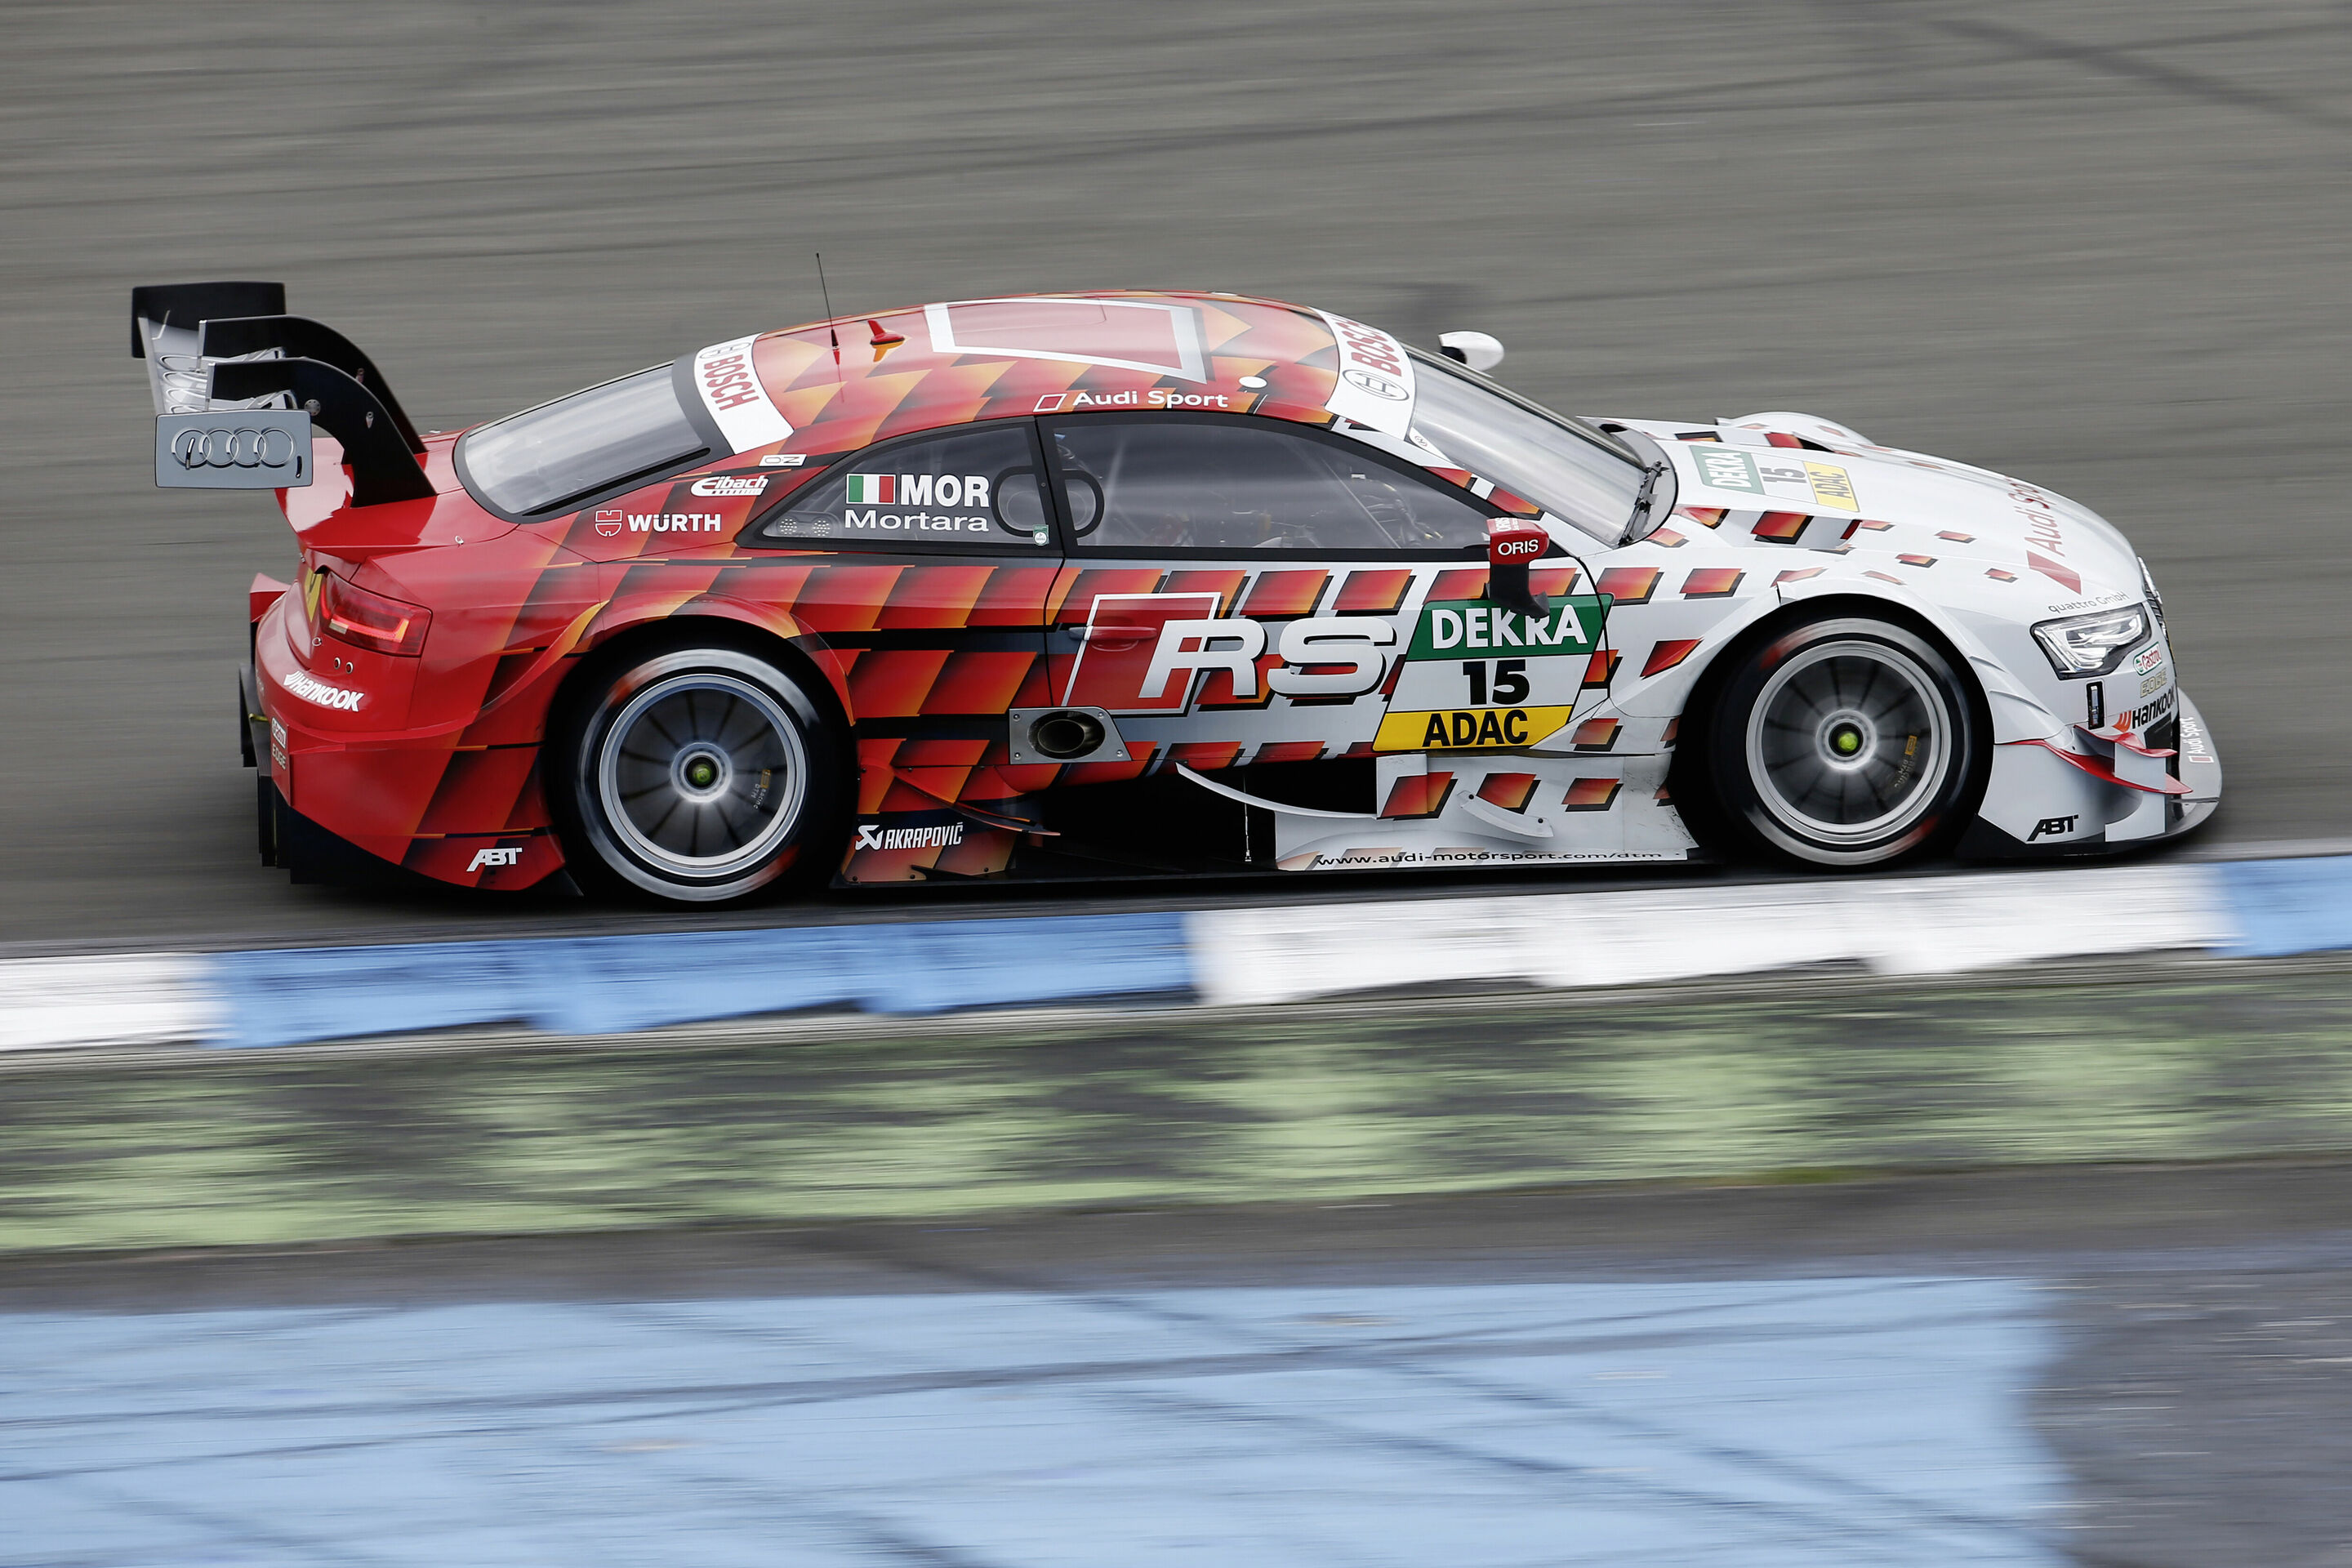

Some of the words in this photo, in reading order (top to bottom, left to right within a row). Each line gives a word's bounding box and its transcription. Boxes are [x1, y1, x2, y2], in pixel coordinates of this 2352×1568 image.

[703, 354, 760, 411] BOSCH
[1072, 389, 1138, 408] Audi
[1148, 390, 1228, 409] Sport
[1701, 452, 1752, 488] DEKRA
[1759, 466, 1807, 483] 15
[691, 475, 769, 496] Eibach
[902, 474, 989, 508] MOR
[1810, 471, 1852, 499] ADAC
[627, 513, 721, 532] WÜRTH
[844, 509, 989, 532] Mortara
[2015, 506, 2066, 558] Audi
[1498, 539, 1539, 555] ORIS
[2048, 599, 2096, 614] quattro
[2096, 590, 2130, 606] GmbH
[1431, 604, 1588, 650] DEKRA
[1138, 617, 1396, 698] RS
[1463, 659, 1530, 706] 15
[2140, 666, 2168, 699] EDGE
[1422, 709, 1530, 748] ADAC
[2180, 716, 2203, 738] Sport
[2181, 737, 2207, 754] Audi
[2026, 814, 2079, 842] ABT
[466, 847, 523, 872] ABT
[1316, 851, 1663, 866] www.audi-motorsport.com/dtm
